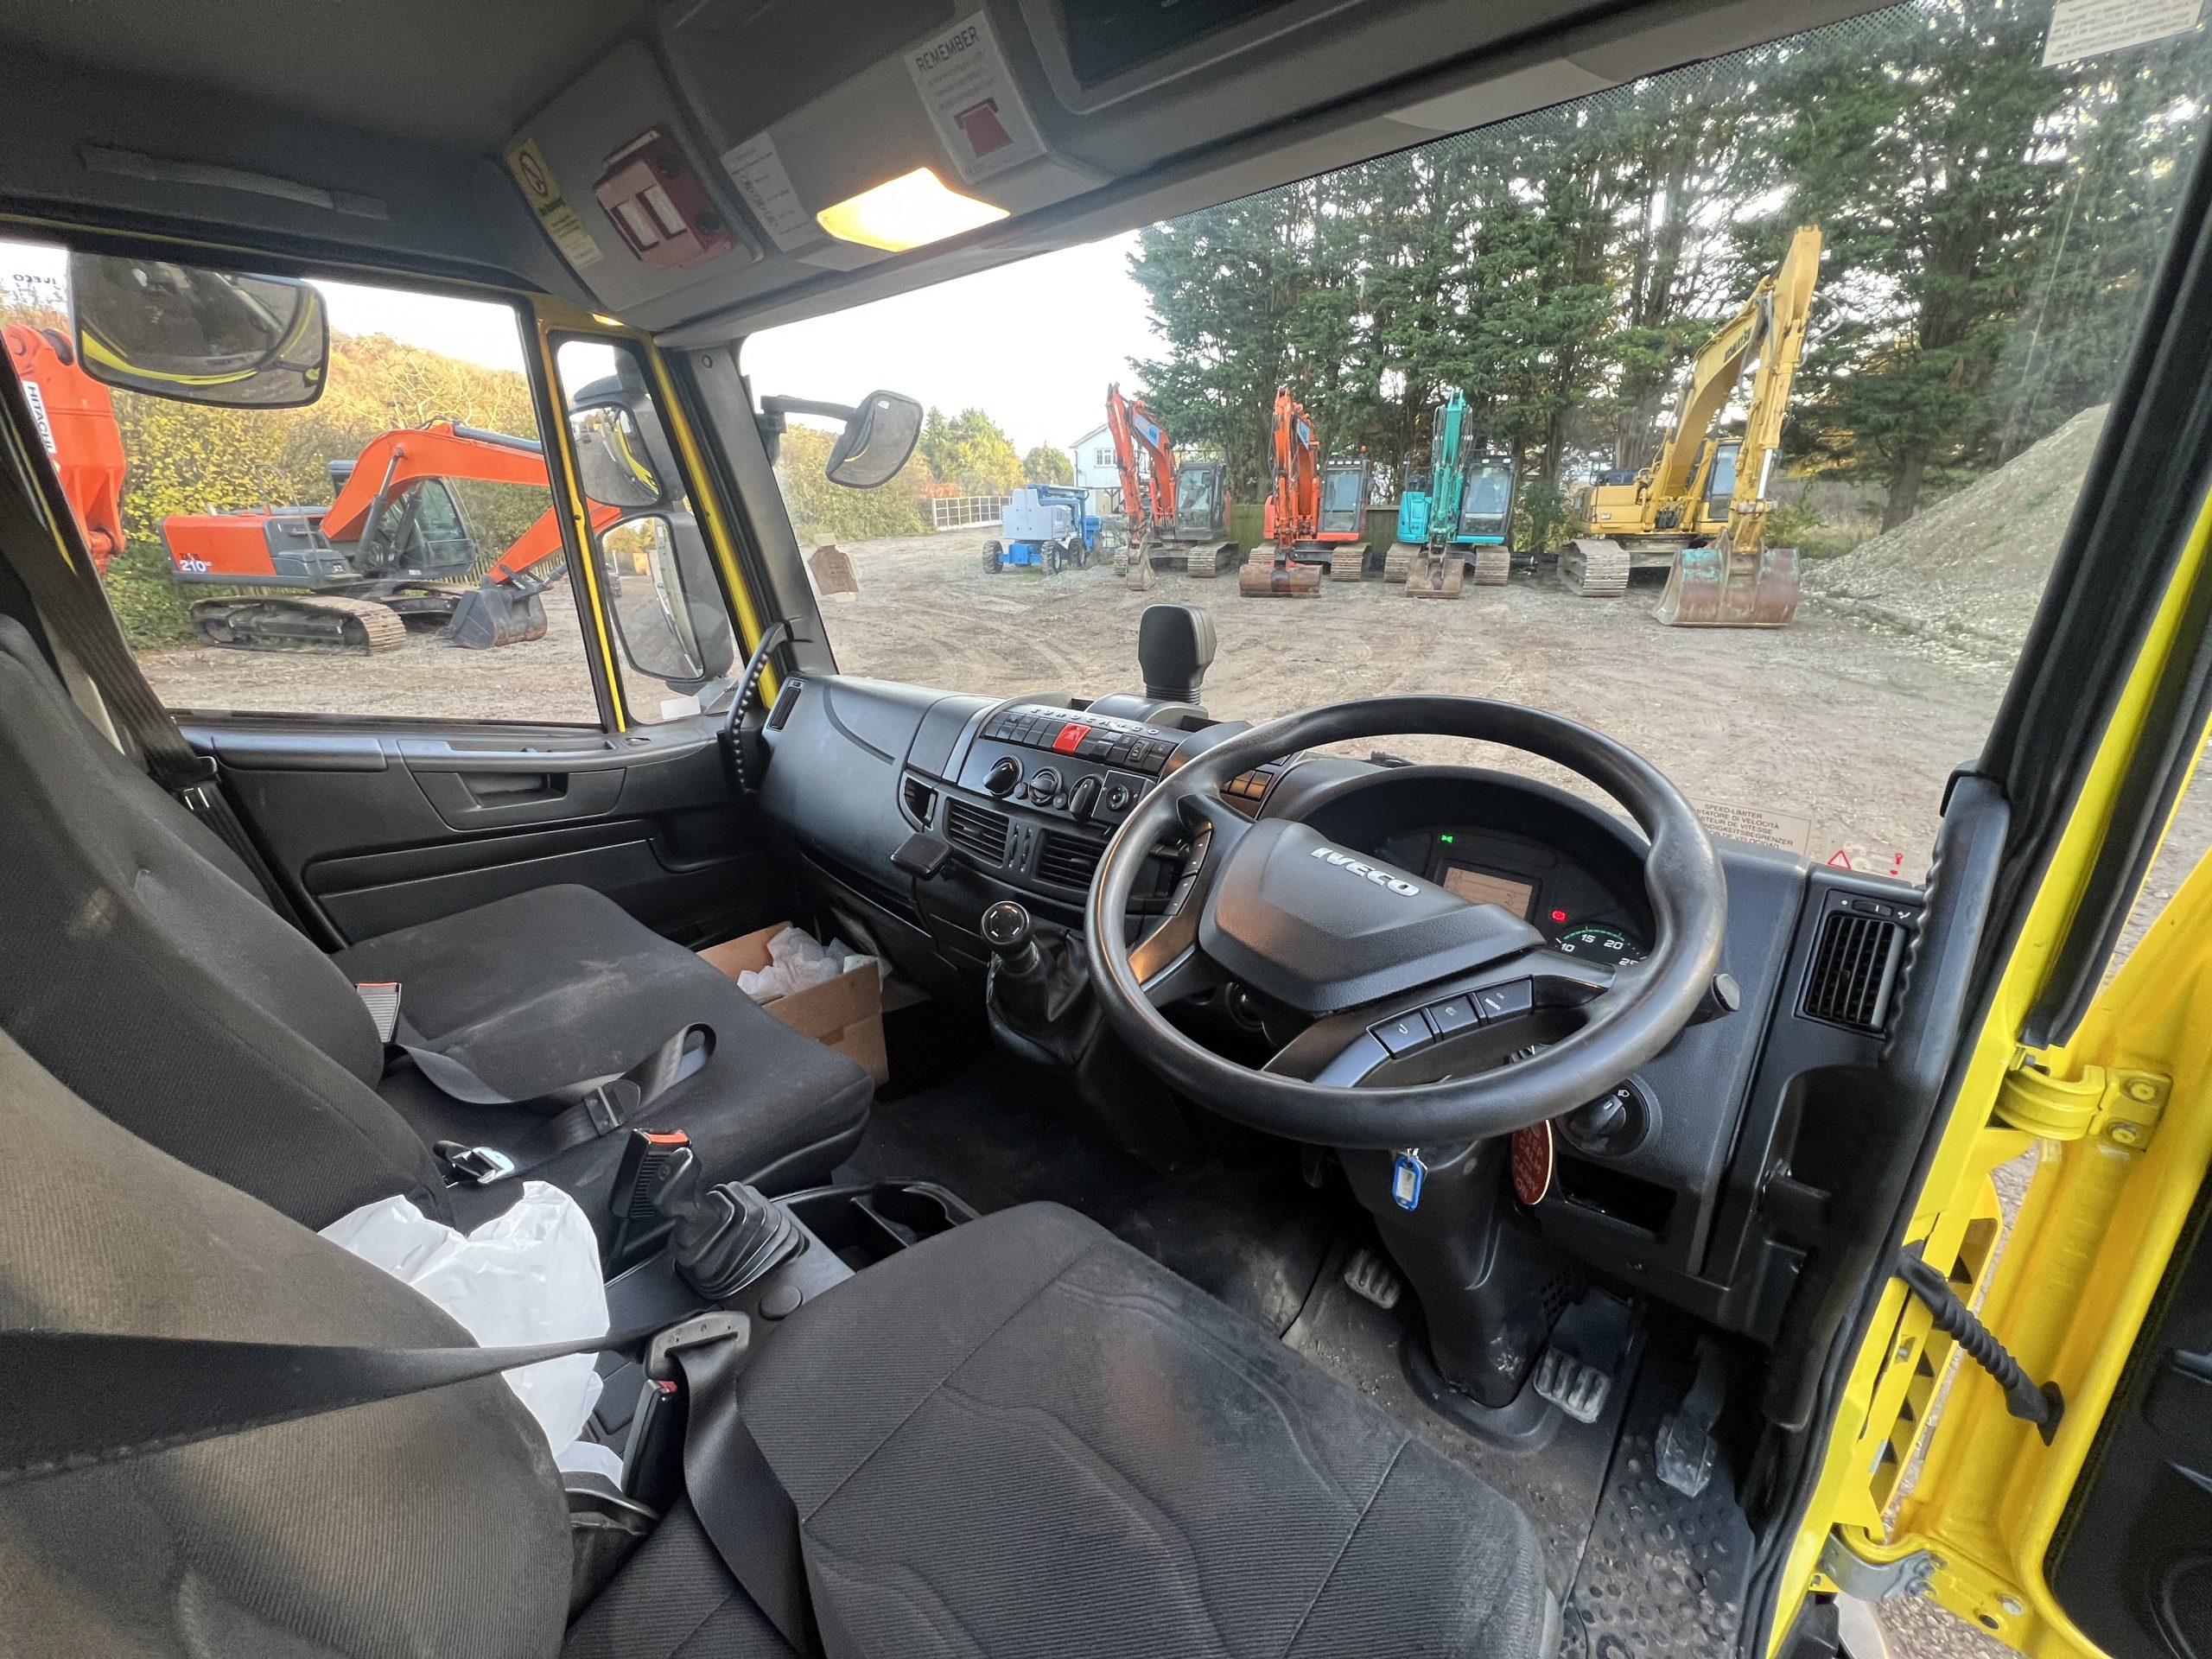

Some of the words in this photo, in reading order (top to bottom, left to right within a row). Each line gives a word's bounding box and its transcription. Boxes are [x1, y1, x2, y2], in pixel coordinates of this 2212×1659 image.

[915, 26, 980, 73] REMEMBER
[28, 385, 53, 448] HITACHI
[180, 559, 207, 572] 210
[1704, 823, 1794, 847] NDIGKEITSBEGRENZER
[1740, 823, 1772, 836] VITESSE
[1310, 847, 1421, 897] IVECO
[1581, 933, 1596, 944] 15
[1603, 939, 1624, 950] 20
[1560, 943, 1575, 952] 10
